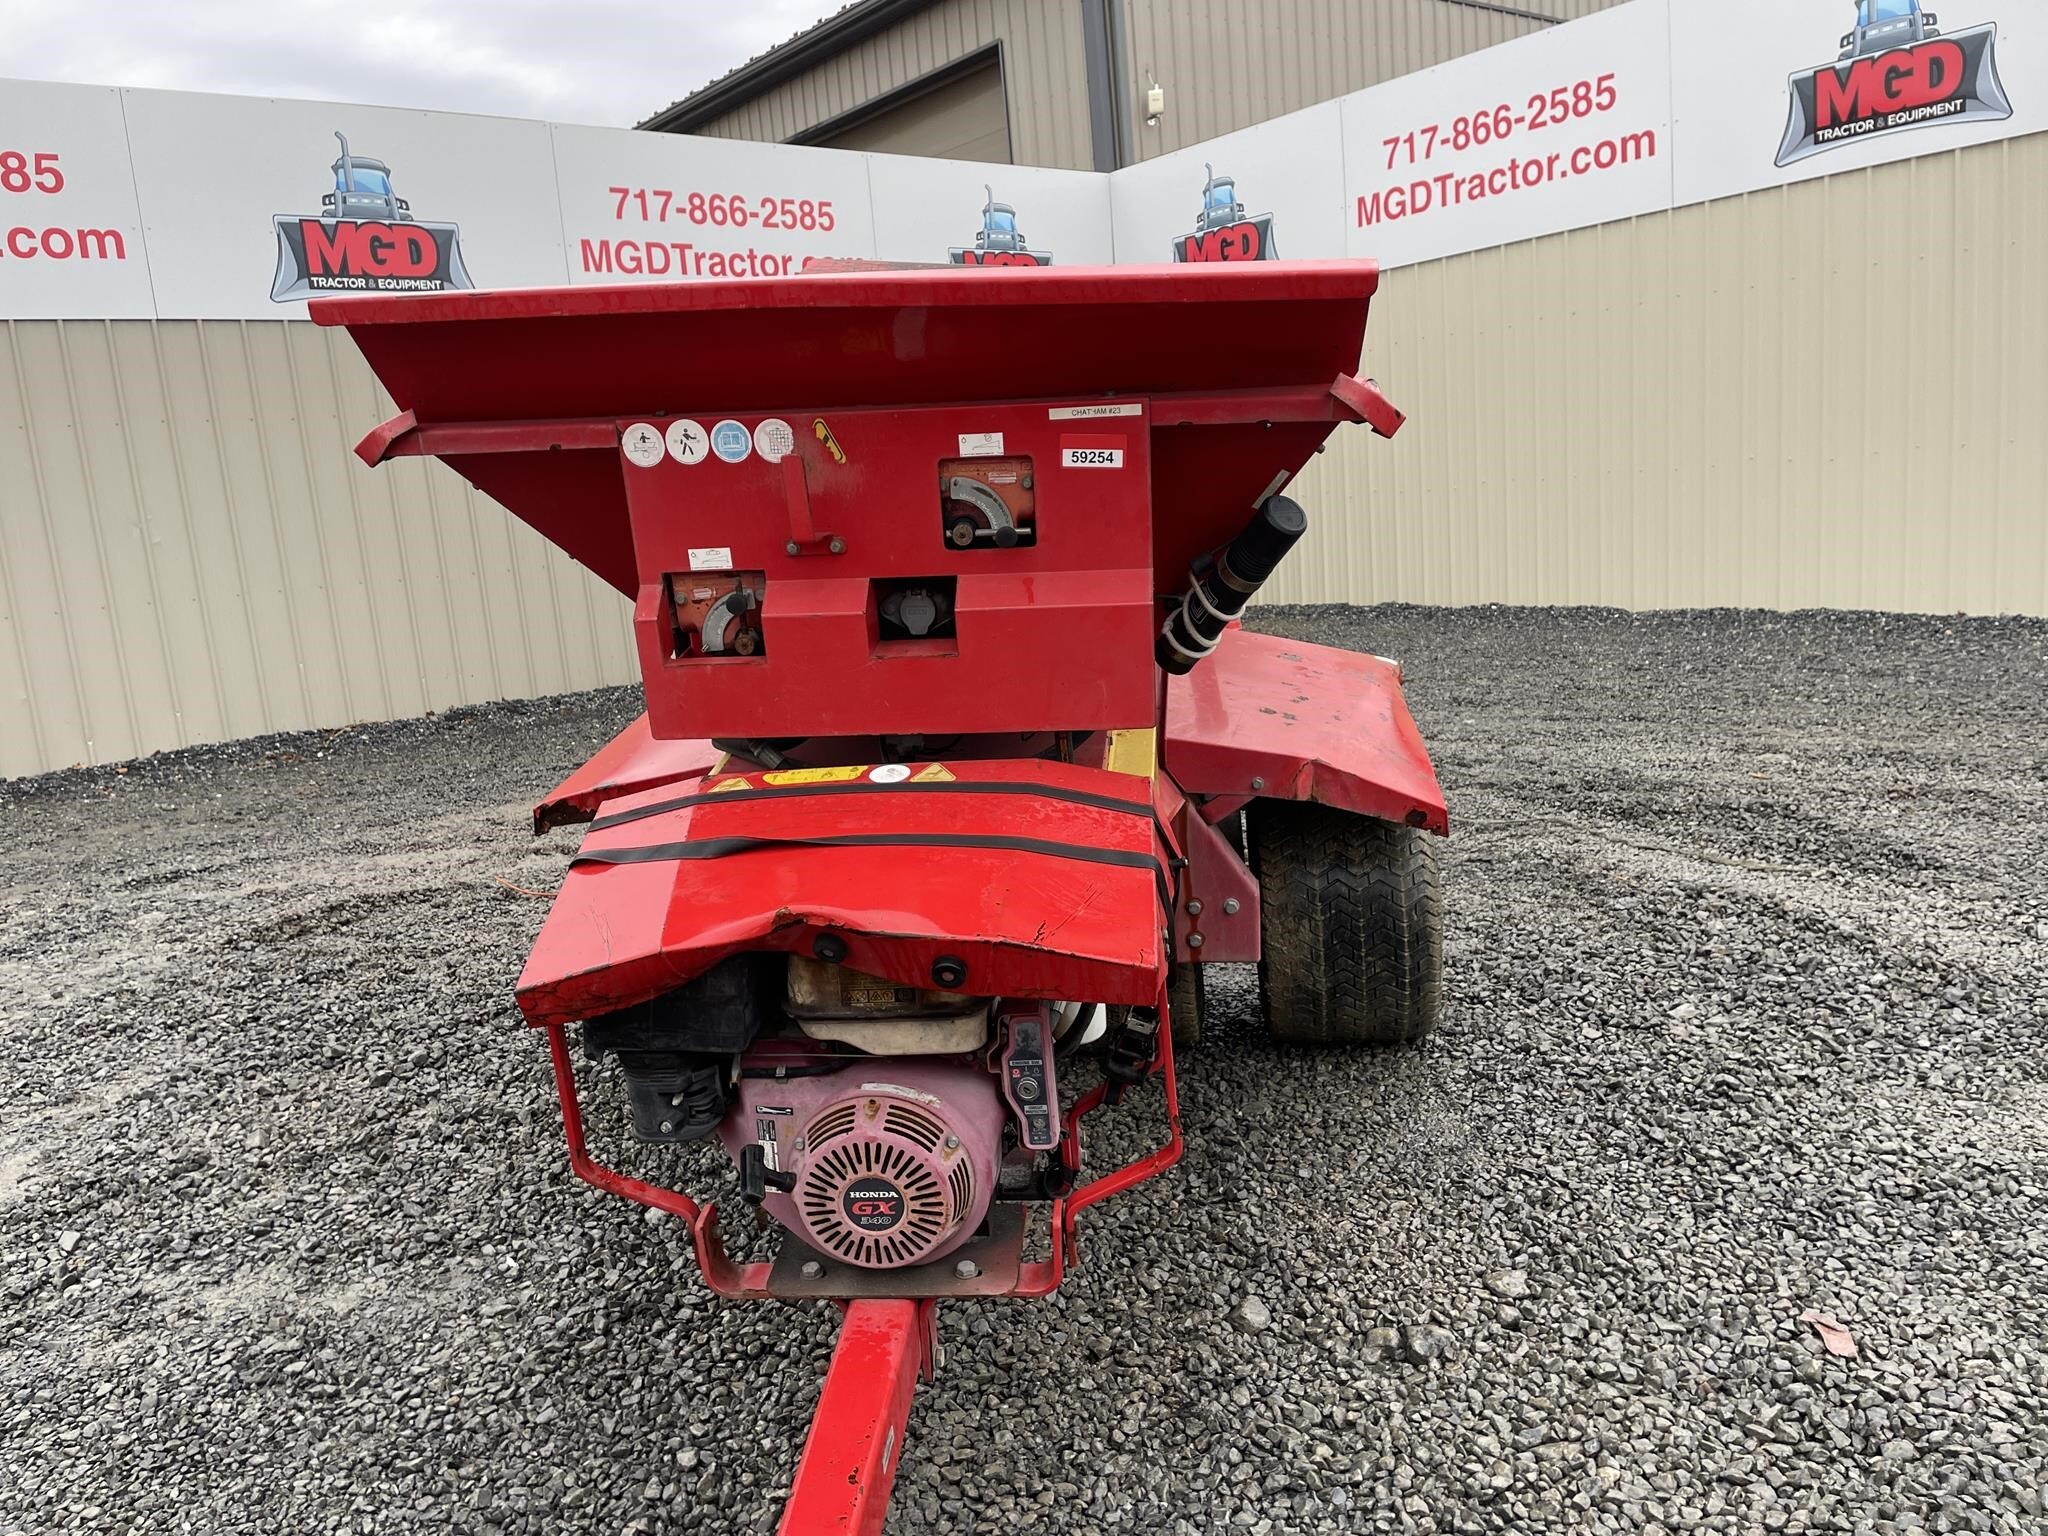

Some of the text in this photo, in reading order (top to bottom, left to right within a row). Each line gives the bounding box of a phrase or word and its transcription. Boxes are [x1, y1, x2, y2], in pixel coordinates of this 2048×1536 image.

[1815, 41, 1964, 127] MGD
[1383, 72, 1617, 169] 717-866-2585
[1816, 99, 1963, 141] TRACTOR & EQUIPMENT
[0, 151, 64, 194] 85
[1357, 129, 1656, 227] MGDTractor.com
[609, 186, 835, 232] 717-866-2585
[301, 220, 438, 277] MGD
[580, 239, 862, 279] MGDTractor.
[1185, 222, 1259, 262] MGD
[311, 277, 441, 290] TRACTOR & EQUIPMENT
[1071, 451, 1114, 463] 59254
[852, 1201, 896, 1215] GX
[860, 1216, 892, 1225] 340
